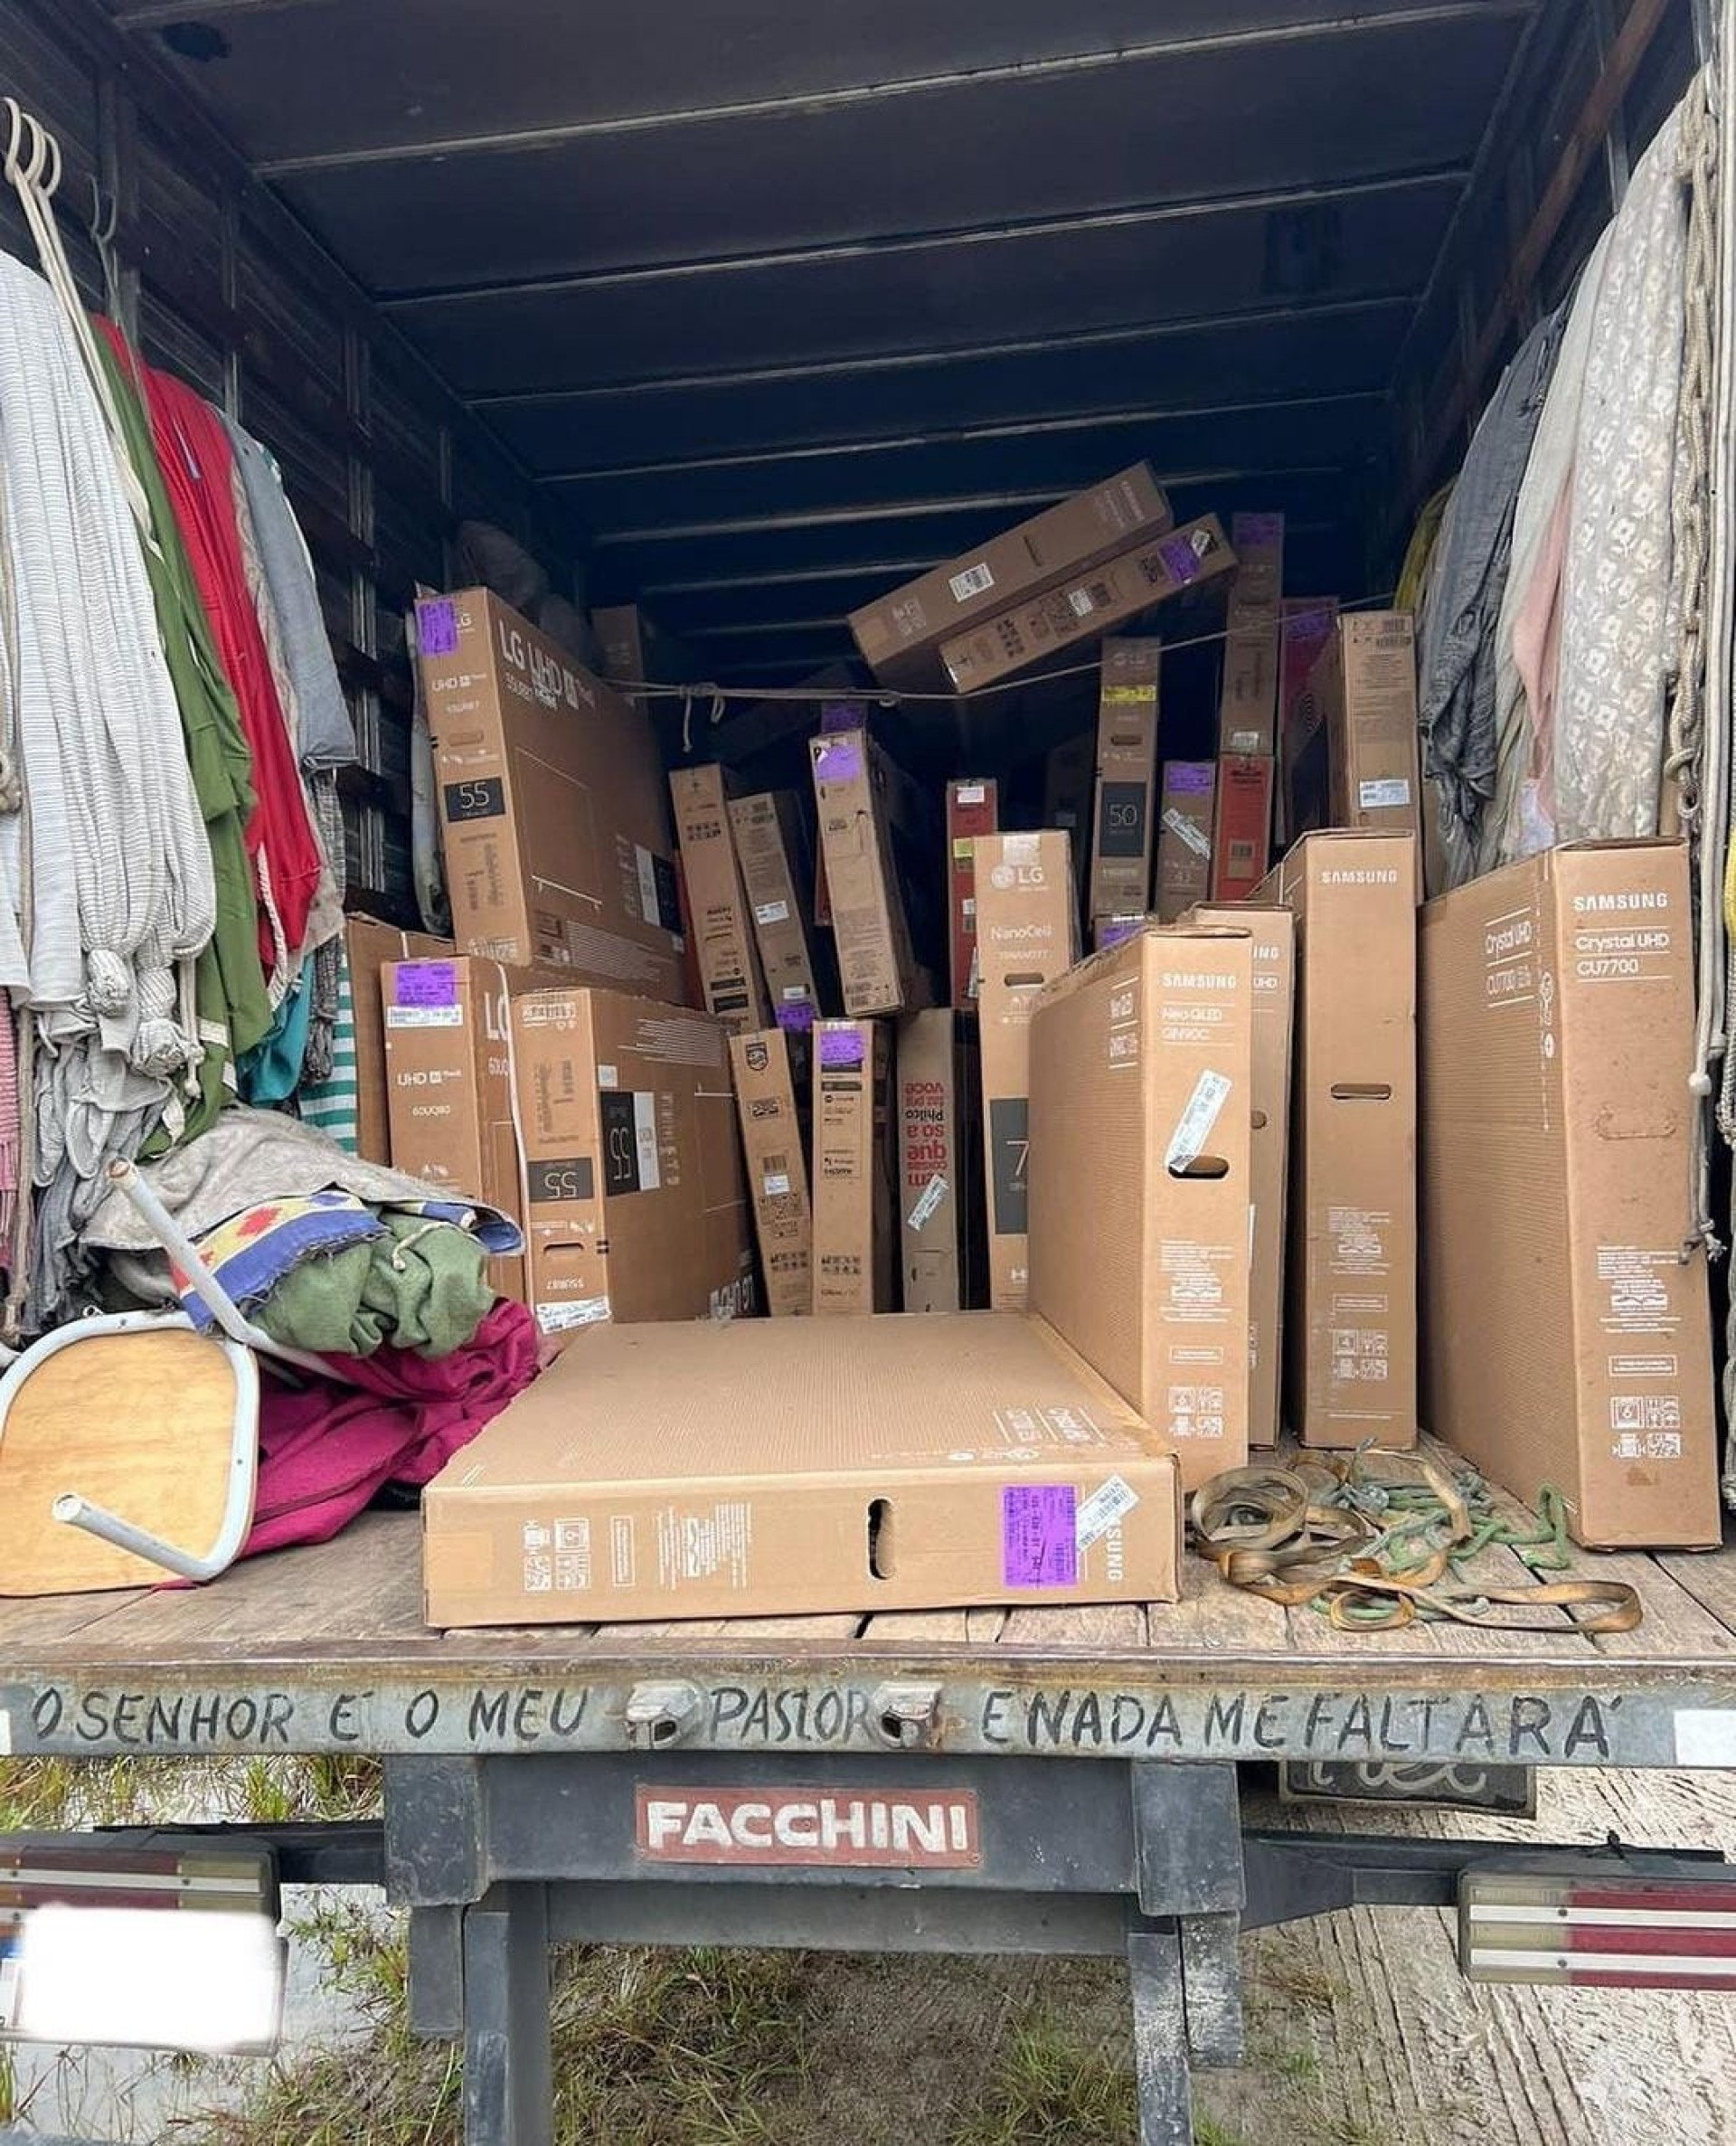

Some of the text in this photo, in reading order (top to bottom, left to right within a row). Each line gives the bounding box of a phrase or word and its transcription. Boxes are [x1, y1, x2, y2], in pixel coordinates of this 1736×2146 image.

[499, 619, 525, 670] LG
[458, 780, 490, 809] 55
[1109, 803, 1137, 826] 50
[1018, 866, 1043, 884] LG
[1321, 869, 1399, 884] SAMSUNG
[1573, 892, 1668, 912] SAMSUNG
[990, 925, 1053, 941] NanoCell
[1576, 933, 1670, 952] Crystal UHD
[1576, 959, 1639, 976] CU7700
[1161, 974, 1237, 989] SAMSUNG
[905, 1109, 945, 1122] Philco
[609, 1127, 632, 1180] 55
[907, 1140, 947, 1160] que
[1005, 1140, 1030, 1177] 7
[544, 1172, 578, 1198] 55
[31, 1687, 63, 1739] O
[75, 1689, 295, 1744] SENHOR
[404, 1689, 439, 1740] O
[467, 1687, 590, 1742] MEU
[982, 1690, 1014, 1746] E
[1025, 1689, 1184, 1747] NADA
[1203, 1692, 1290, 1749] ME
[646, 1799, 968, 1853] FACCHINI
